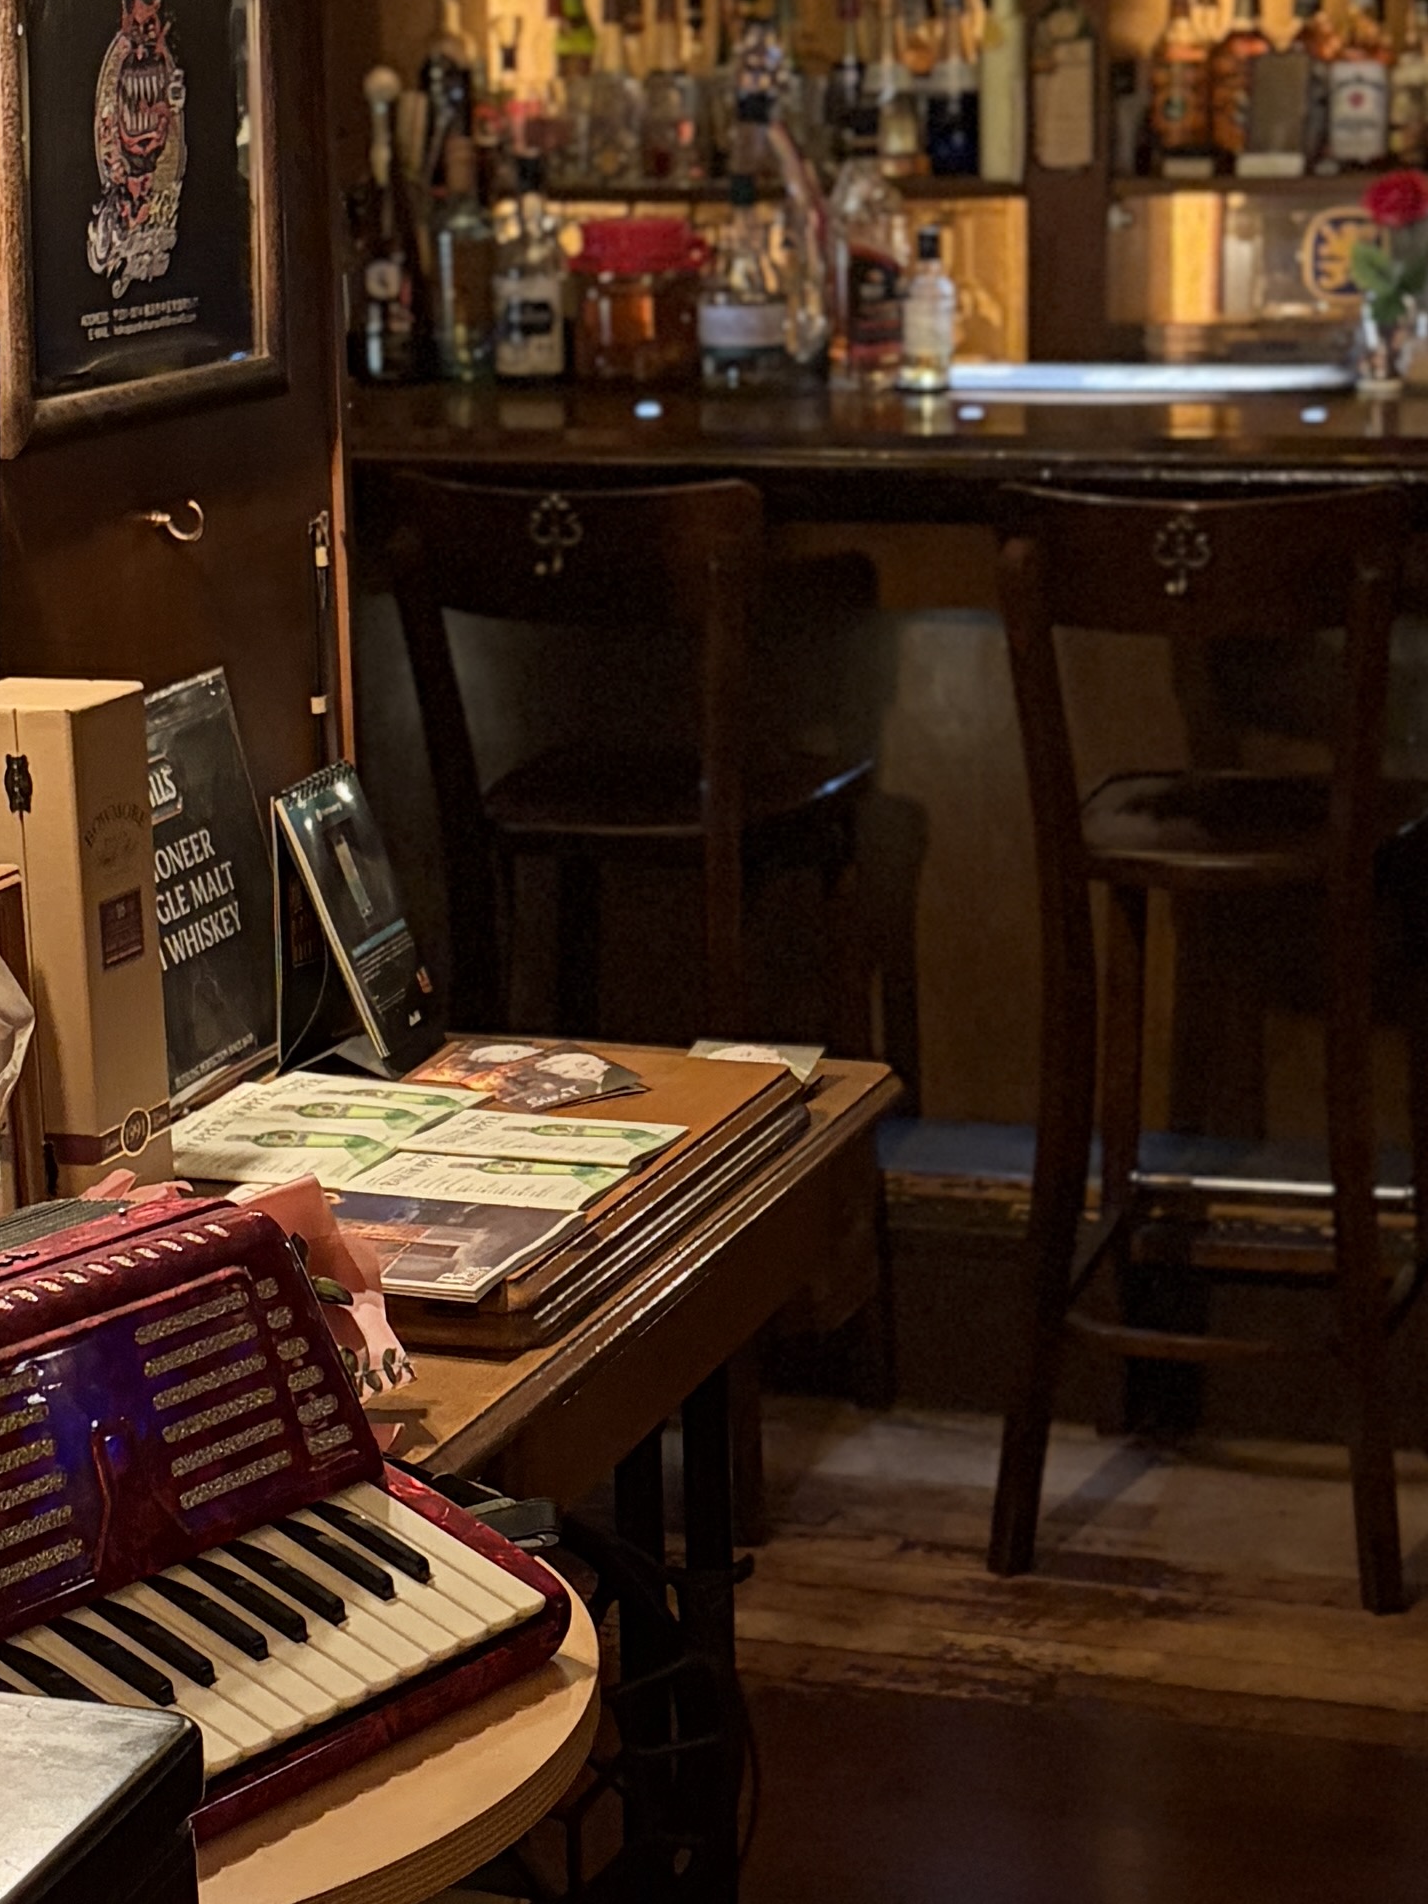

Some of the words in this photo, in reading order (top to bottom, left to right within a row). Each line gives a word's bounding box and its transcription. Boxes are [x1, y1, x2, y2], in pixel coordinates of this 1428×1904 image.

[154, 828, 216, 883] ONEER
[156, 883, 192, 926] GLE
[189, 860, 236, 910] MALT
[163, 901, 242, 965] WHISKEY
